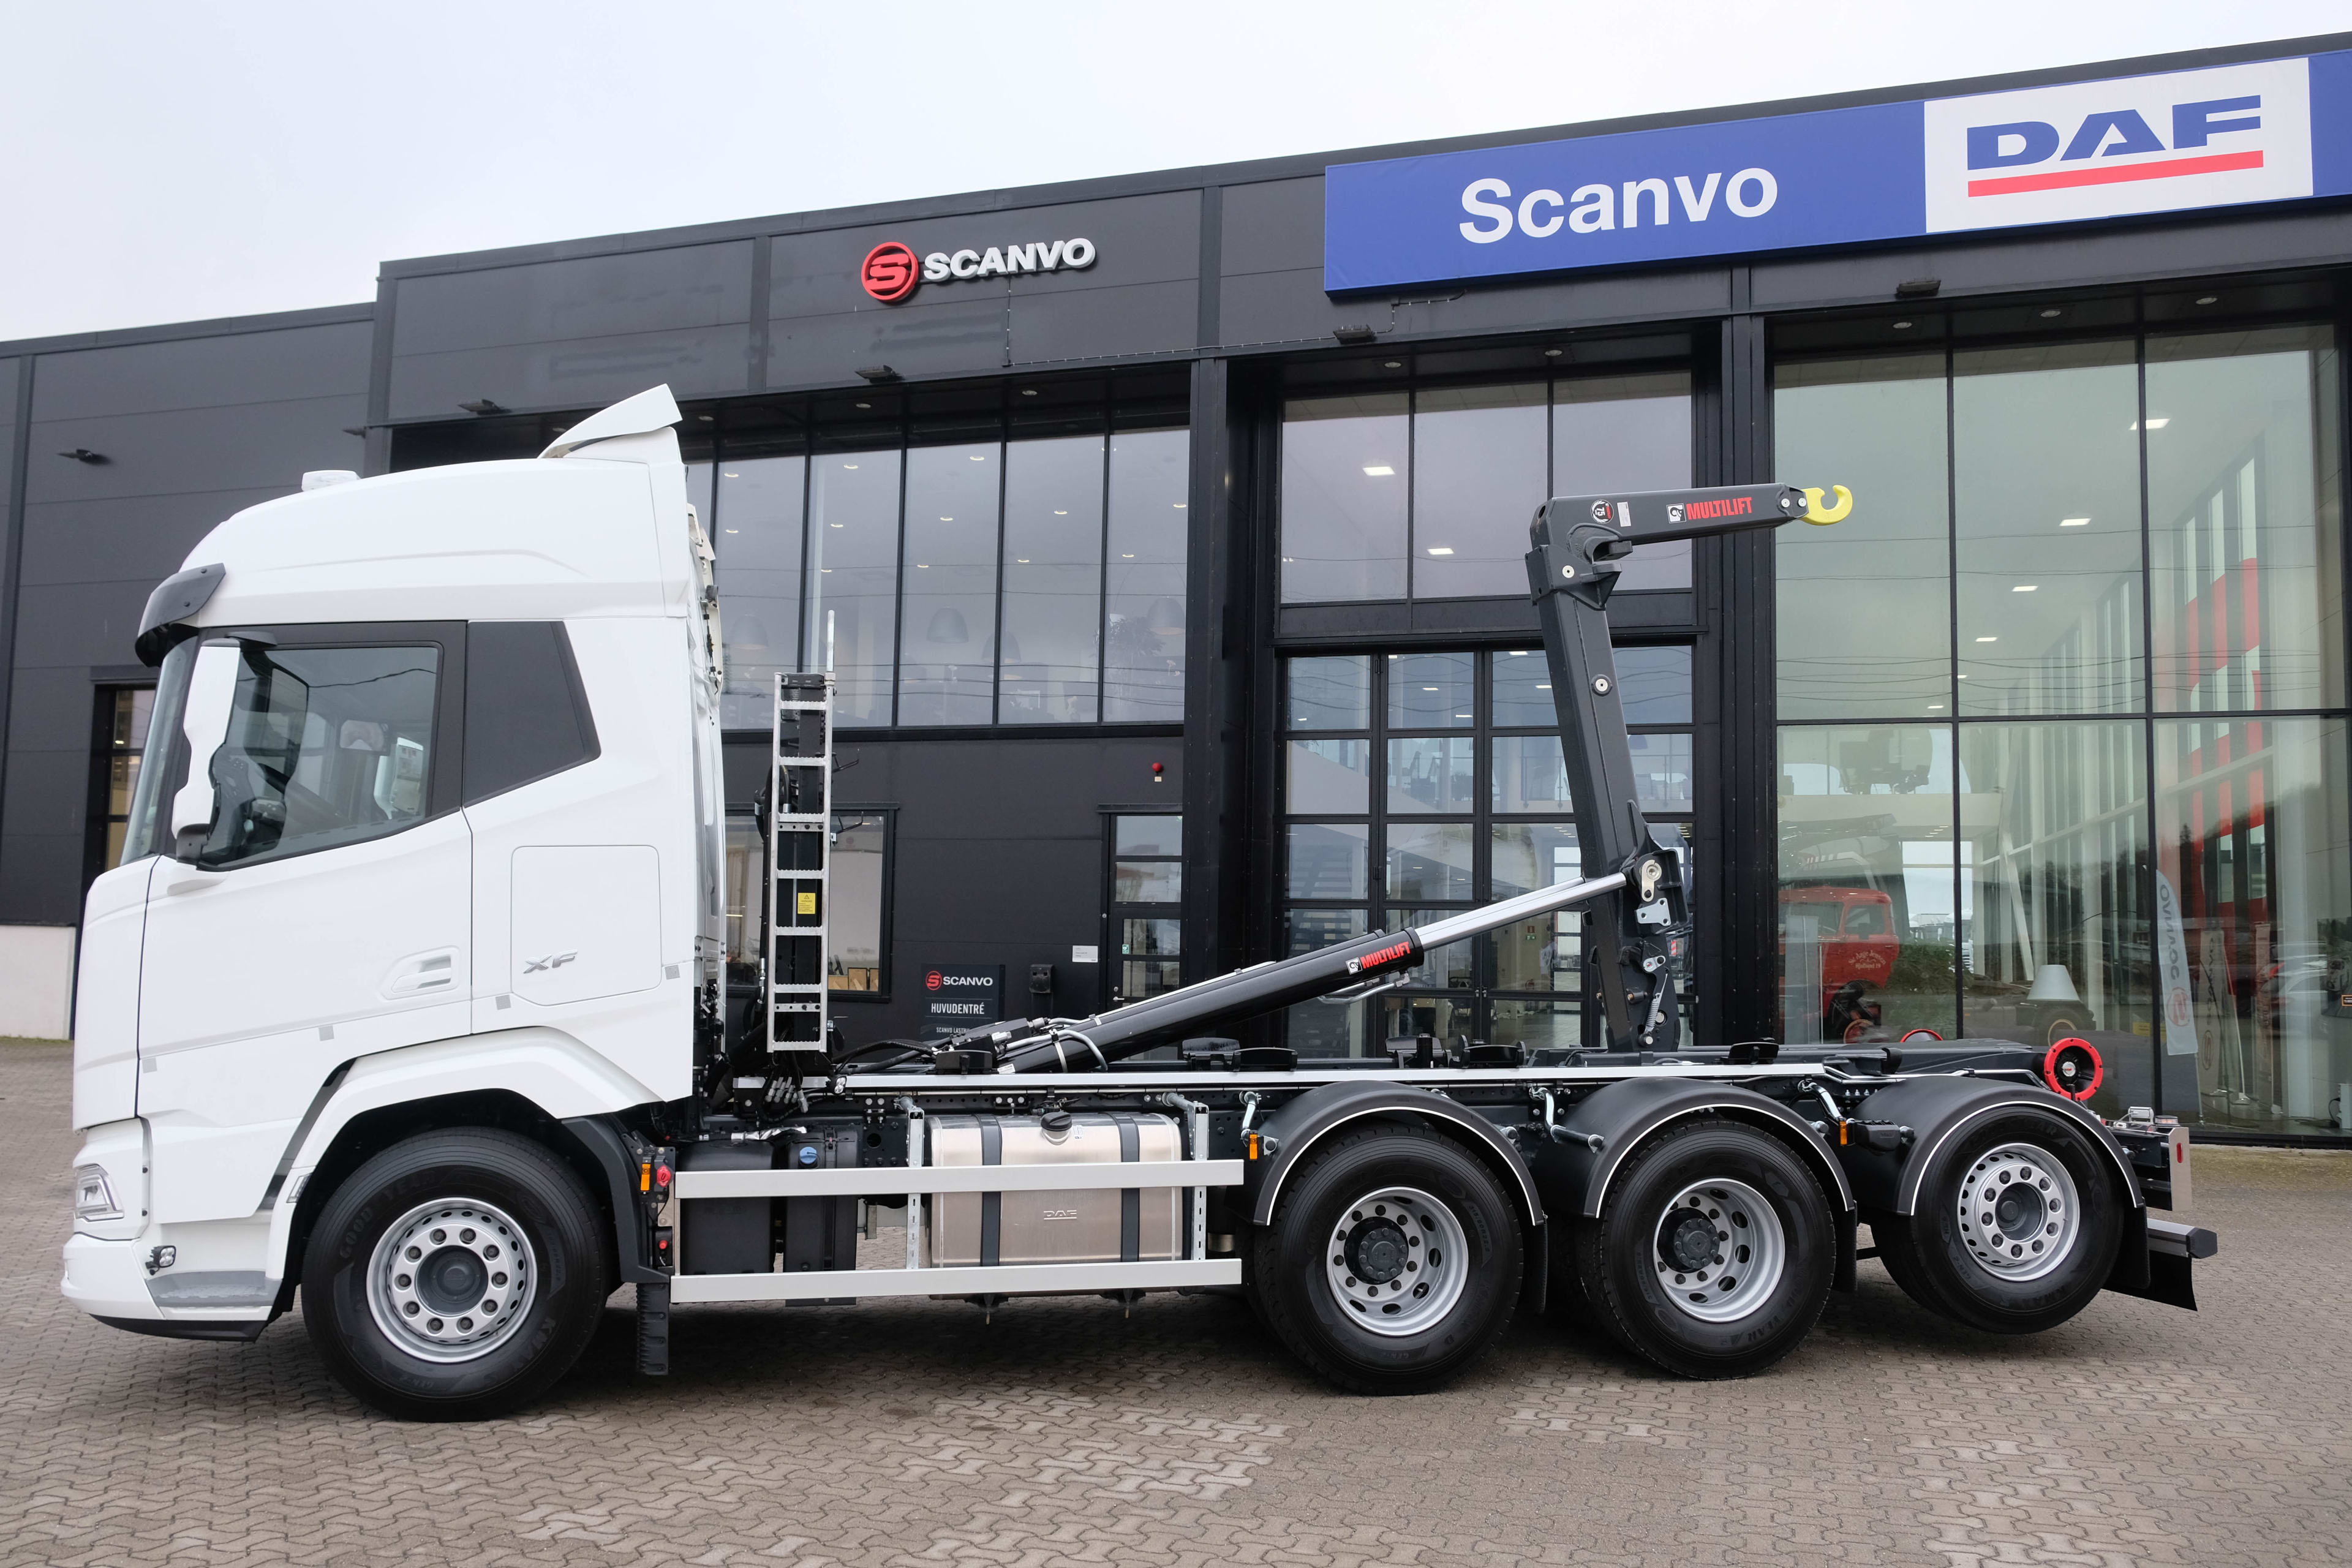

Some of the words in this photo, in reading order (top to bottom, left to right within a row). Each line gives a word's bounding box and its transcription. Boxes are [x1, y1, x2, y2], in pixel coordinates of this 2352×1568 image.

[1967, 94, 2261, 171] DAF
[1459, 167, 1778, 244] Scanvo
[924, 238, 1096, 282] SCANVO
[1686, 497, 1752, 519] MULTILIFT
[523, 949, 578, 974] XF
[1360, 942, 1411, 969] MULTILIFT
[943, 976, 993, 986] SCANVO
[931, 1002, 985, 1014] HUVUDENTRÉ
